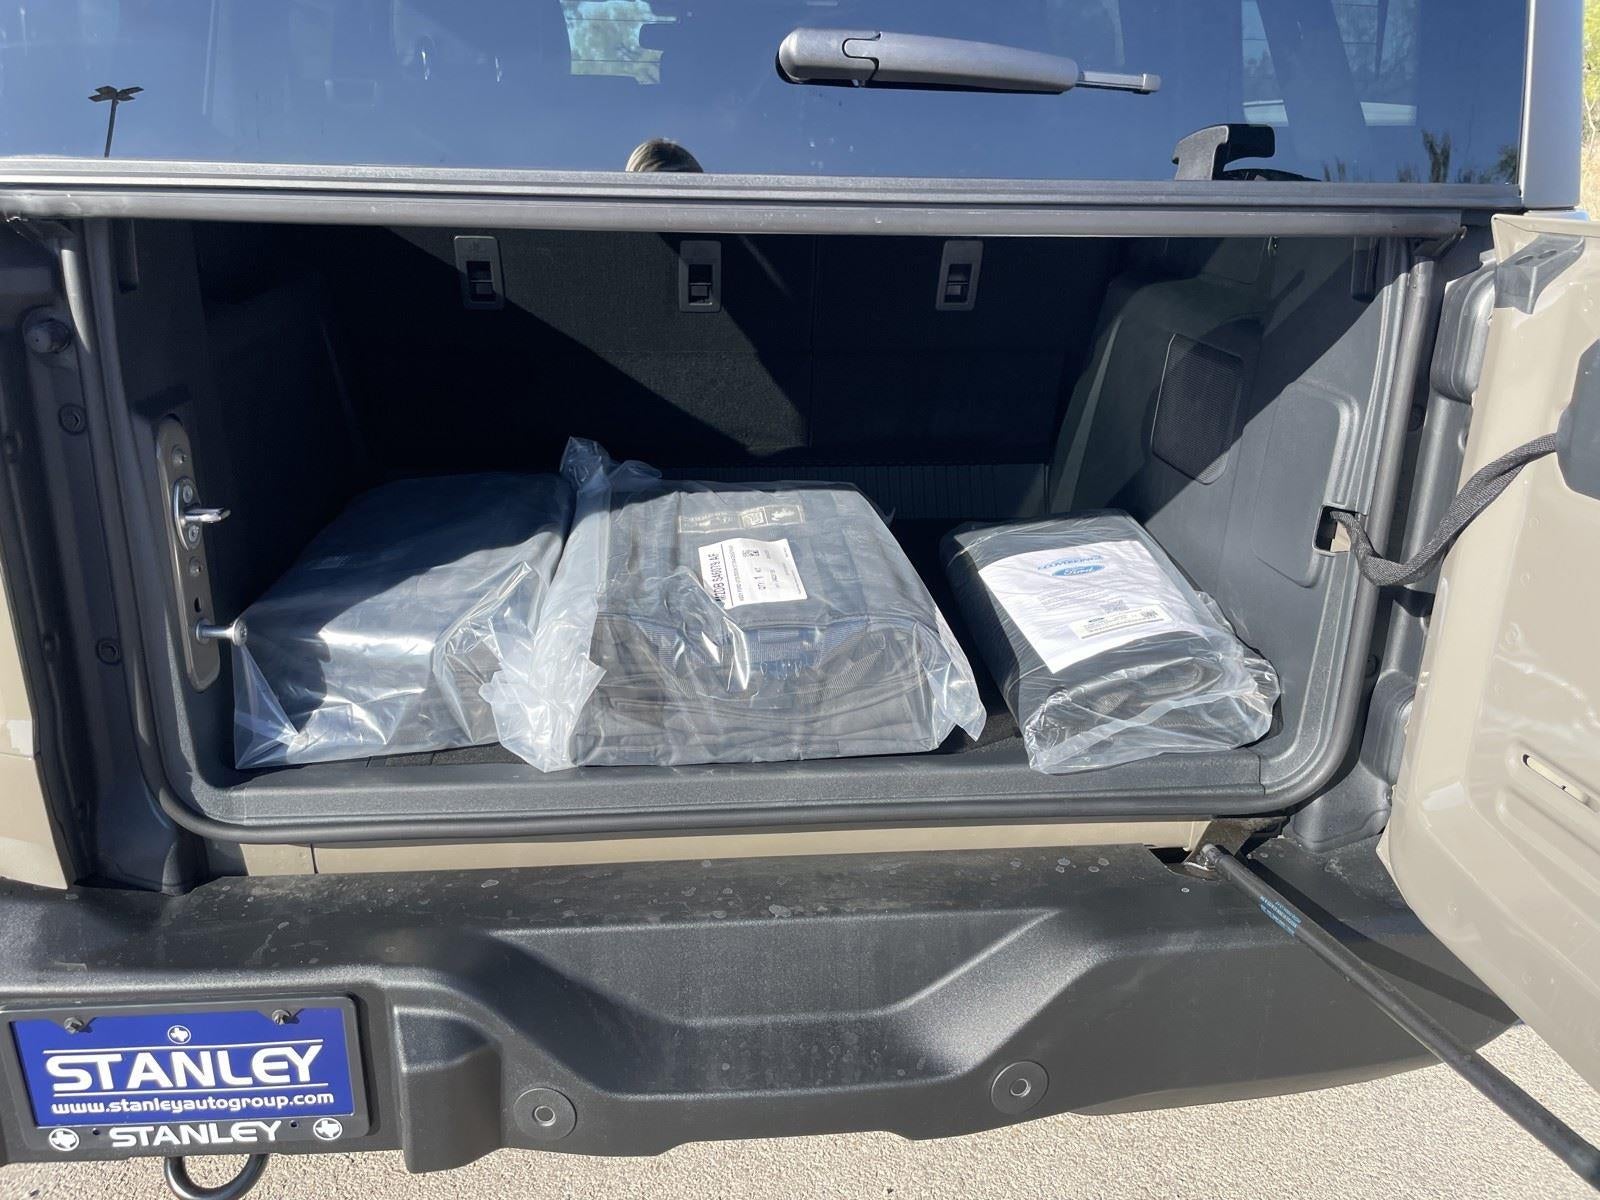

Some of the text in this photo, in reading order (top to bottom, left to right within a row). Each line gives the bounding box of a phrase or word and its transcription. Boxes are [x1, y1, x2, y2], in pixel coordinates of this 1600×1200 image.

[46, 1044, 323, 1092] STANLEY
[51, 1091, 335, 1115] www.stanleyautogroup.com
[108, 1120, 282, 1148] STANLEY
